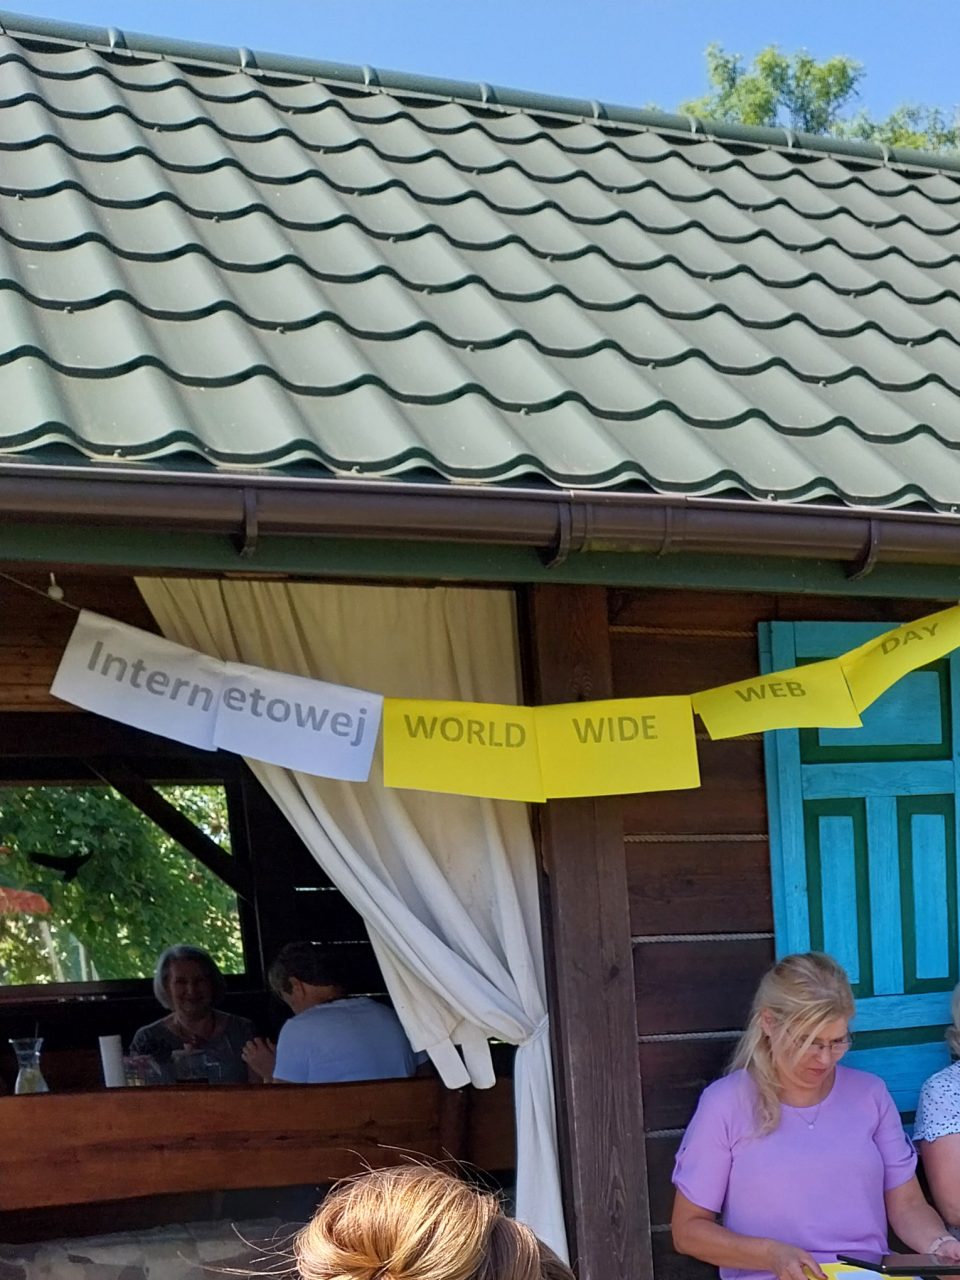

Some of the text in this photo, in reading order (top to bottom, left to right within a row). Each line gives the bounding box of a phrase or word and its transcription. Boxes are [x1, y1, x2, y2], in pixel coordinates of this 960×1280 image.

[403, 622, 939, 748] WORLD WIDE WEB DAY
